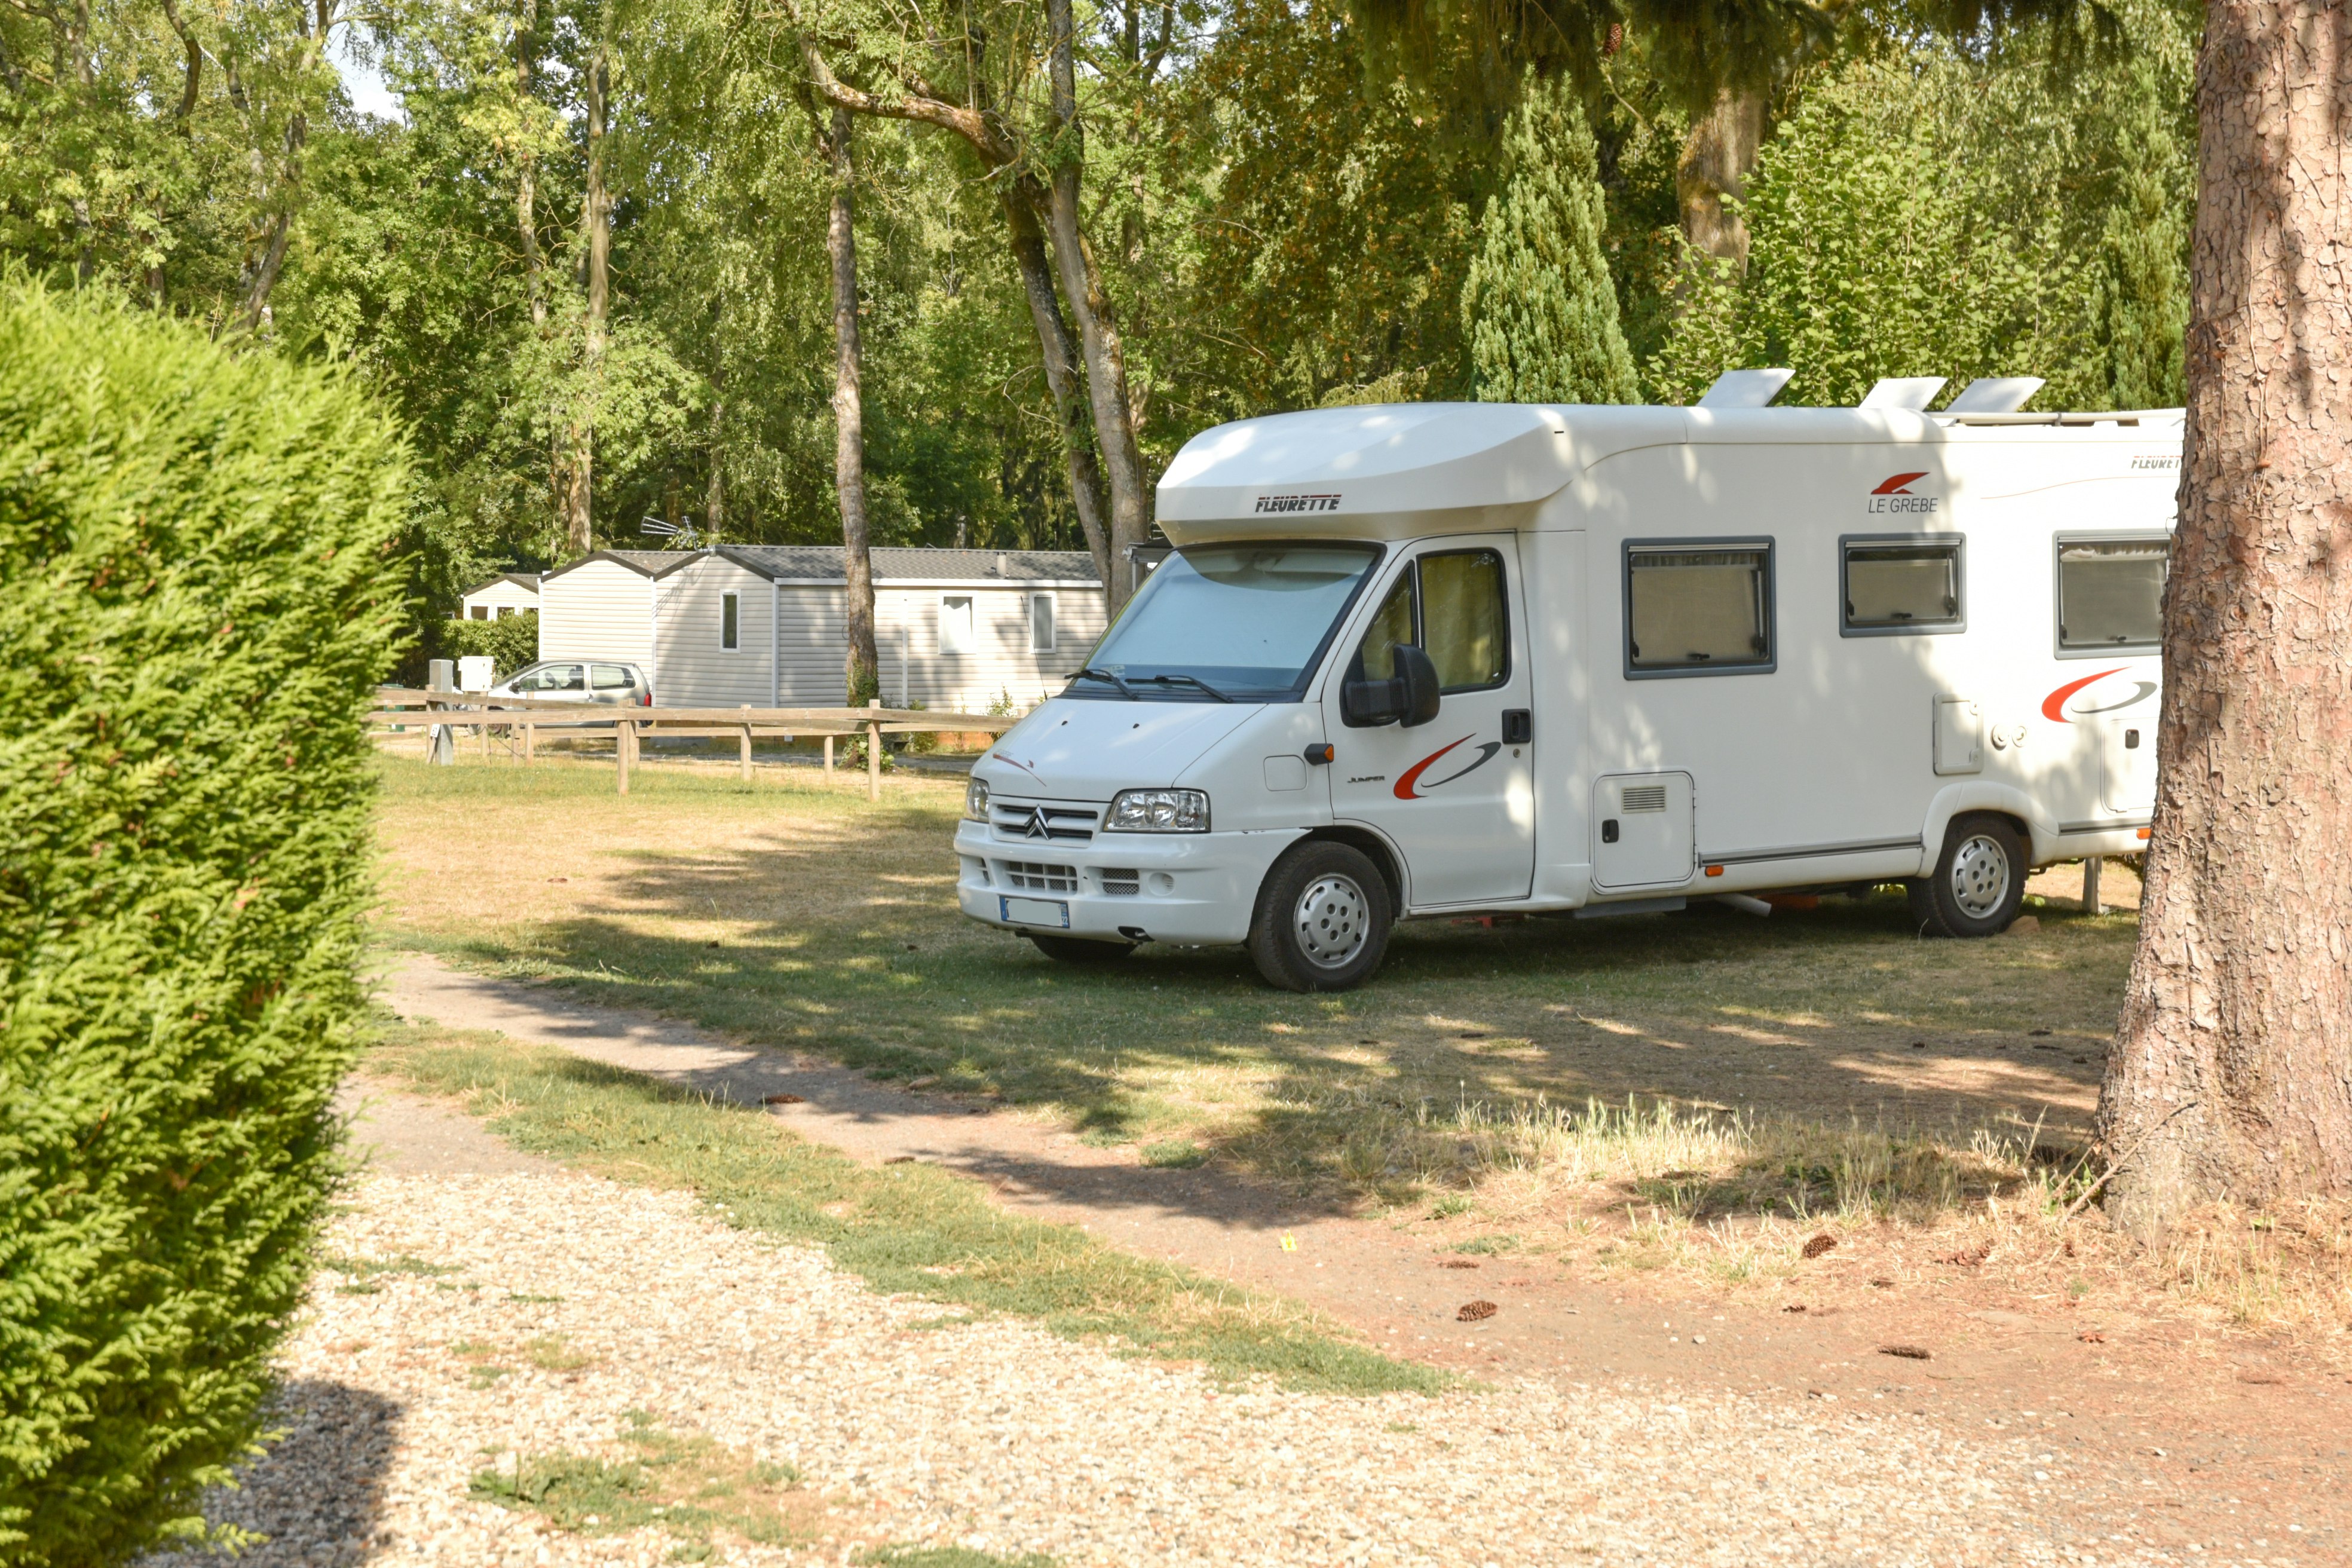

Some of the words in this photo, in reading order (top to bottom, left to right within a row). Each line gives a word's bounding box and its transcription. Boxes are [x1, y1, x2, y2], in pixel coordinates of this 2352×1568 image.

[1255, 494, 1342, 513] FLEURETTE
[1868, 498, 1886, 513] LE
[1890, 498, 1938, 513] GREBE
